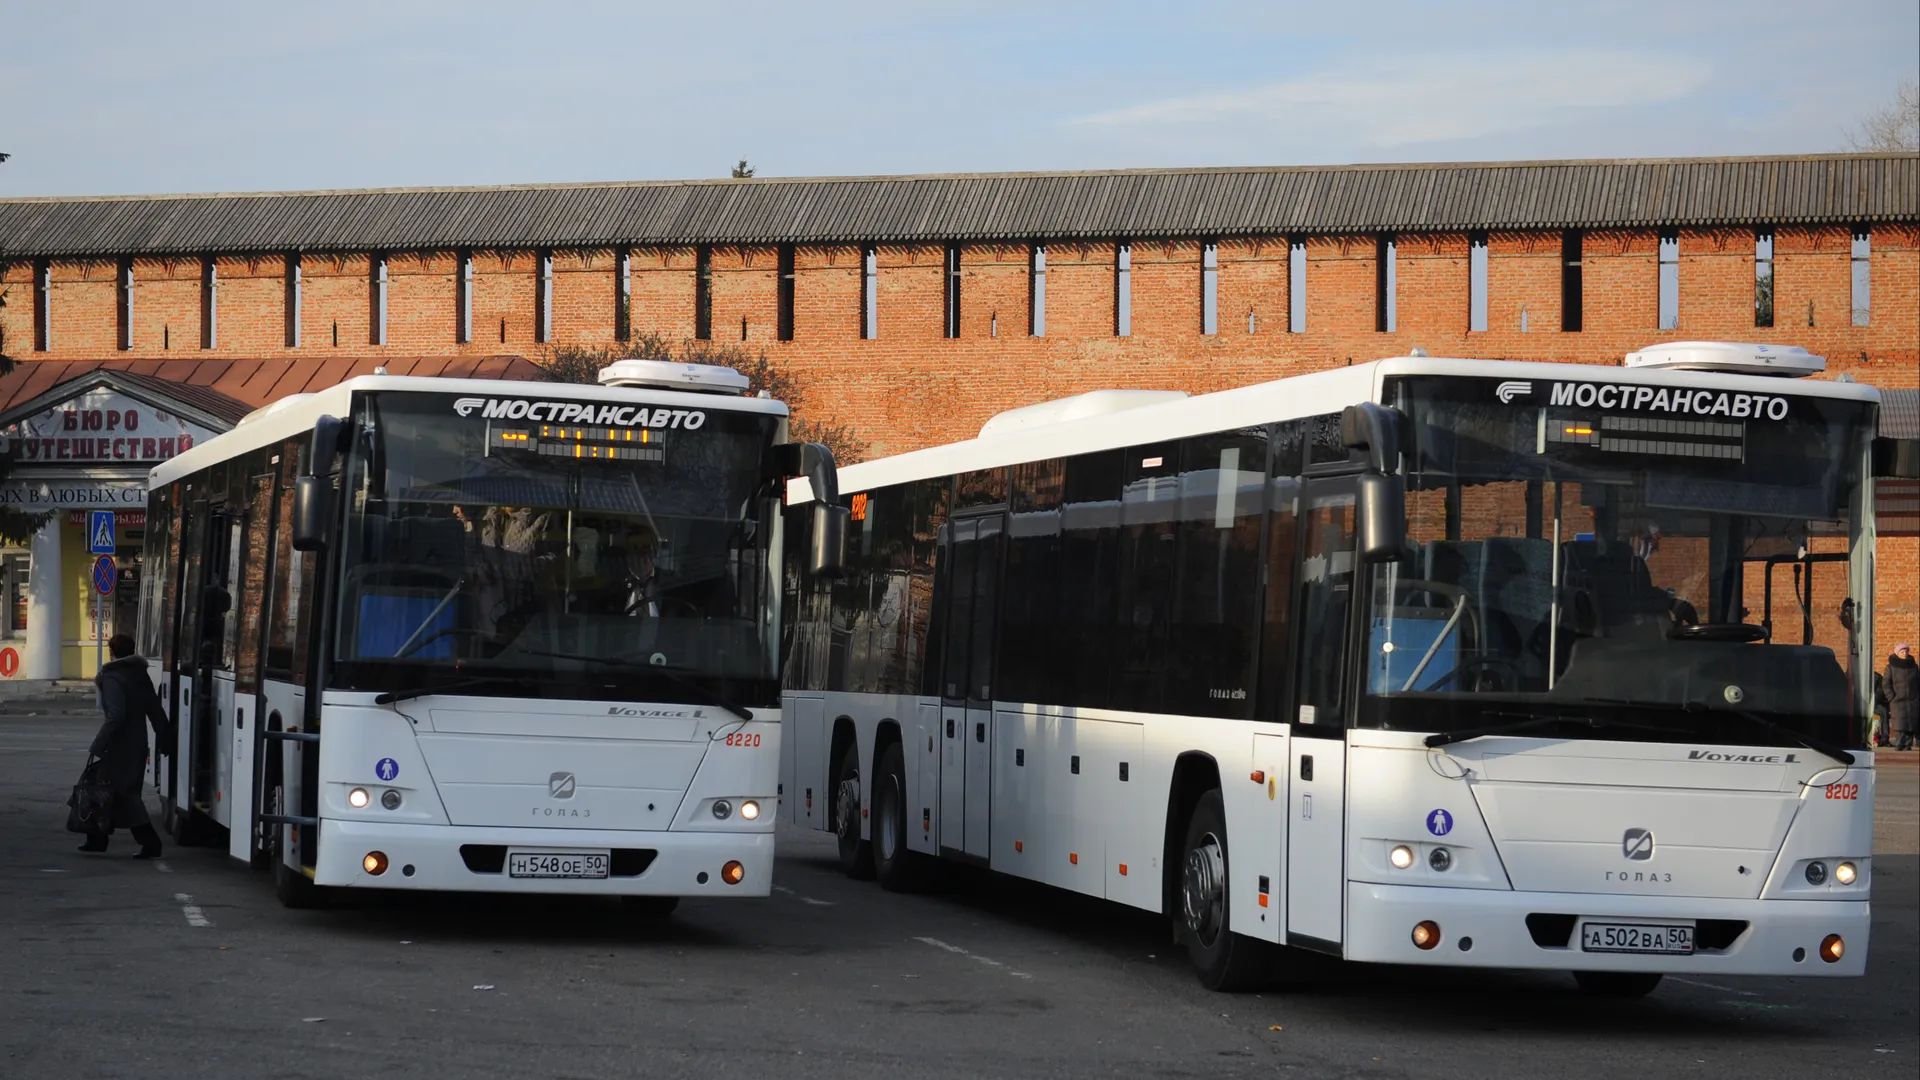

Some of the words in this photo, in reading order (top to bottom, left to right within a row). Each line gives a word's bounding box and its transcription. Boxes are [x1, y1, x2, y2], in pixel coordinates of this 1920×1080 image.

[1550, 383, 1788, 420] МОСТРАНСАВТО
[63, 410, 139, 431] БЮРО
[481, 399, 706, 430] МОСТРАНСАВТО
[29, 489, 40, 503] В
[44, 488, 117, 503] ЛЮБЫХ
[693, 710, 708, 719] L
[726, 733, 761, 748] 8220
[1784, 754, 1801, 764] L
[1825, 784, 1858, 800] 8202
[532, 807, 591, 818] ГОЛАЗ
[586, 857, 602, 869] 50
[1605, 871, 1672, 883] ГОЛАЗ
[1669, 929, 1687, 943] 50
